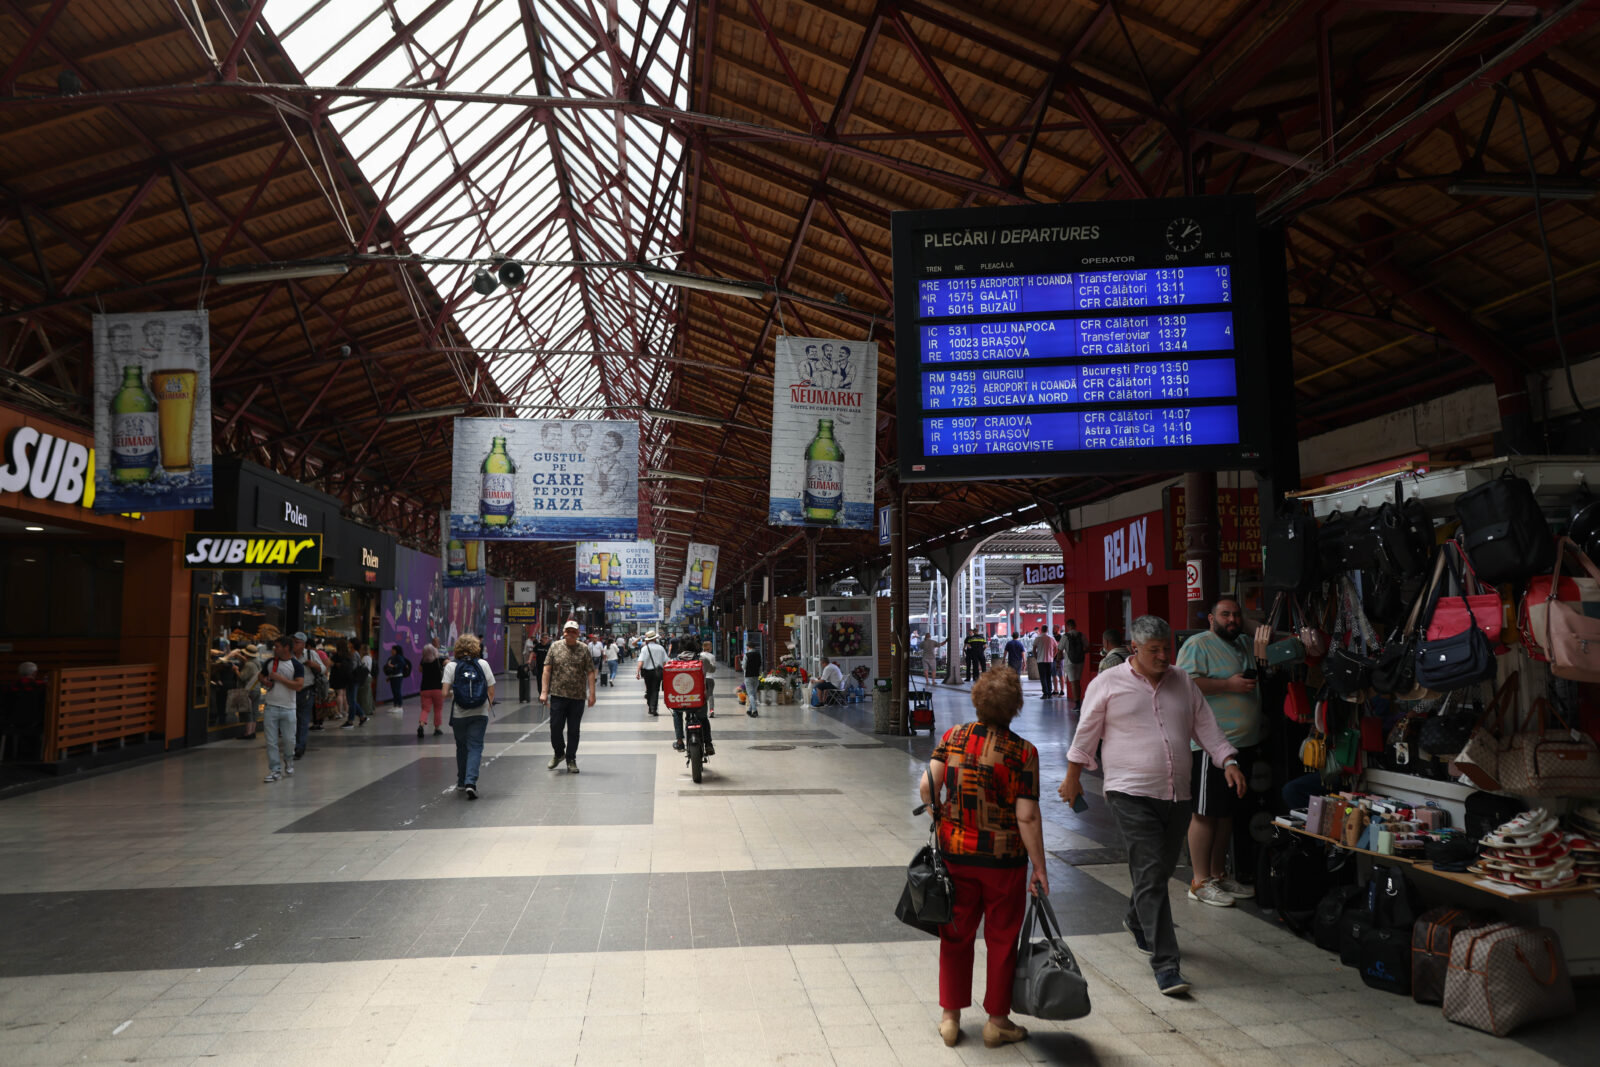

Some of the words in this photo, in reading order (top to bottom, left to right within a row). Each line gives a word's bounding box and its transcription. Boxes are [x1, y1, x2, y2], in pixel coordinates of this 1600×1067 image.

[925, 229, 987, 247] PLECĂRI
[992, 230, 996, 244] /
[1001, 226, 1100, 244] DEPARTURES
[1082, 256, 1135, 264] OPERATOR
[948, 280, 976, 290] 10115
[980, 277, 1024, 288] AEROPORT
[1028, 277, 1033, 285] H
[1037, 274, 1072, 285] COANDĂ
[1079, 272, 1147, 283] Transferoviar
[1156, 269, 1183, 279] 13:10
[1216, 267, 1227, 277] 10
[948, 292, 973, 302] 1575
[1080, 287, 1100, 296] CFR
[1104, 284, 1147, 294] Călători
[1157, 282, 1184, 292] 13:11
[1222, 280, 1228, 289] 6
[928, 306, 934, 315] R
[948, 304, 974, 314] 5015
[981, 302, 1016, 312] BUZĂU
[1080, 299, 1100, 308] CFR
[1105, 296, 1147, 307] Călători
[1157, 294, 1185, 304] 13:17
[1223, 292, 1229, 301] 2
[928, 328, 937, 336] IC
[949, 327, 966, 335] 531
[981, 325, 1007, 334] CLUJ
[1011, 322, 1055, 332] NAPOCA
[1080, 320, 1101, 330] CFR
[1106, 317, 1148, 328] Călători
[1158, 316, 1186, 326] 13:30
[929, 340, 937, 348] IR
[950, 338, 978, 347] 10023
[1081, 331, 1150, 342] Transferoviar
[1159, 328, 1187, 338] 13:37
[1225, 326, 1230, 335] 4
[929, 352, 941, 361] RE
[950, 350, 979, 360] 13053
[982, 348, 1030, 359] CRAIOVA
[1082, 345, 1102, 354] CFR
[1107, 342, 1150, 353] Călători
[1159, 341, 1187, 351] 13:44
[929, 374, 944, 383] RM
[950, 372, 976, 381] 9459
[983, 370, 1023, 380] GIURGIU
[1134, 364, 1157, 374] Prog
[1160, 362, 1188, 373] 13:50
[790, 381, 864, 407] NEUMARKT
[930, 386, 944, 395] RM
[951, 384, 976, 394] 7925
[984, 382, 1028, 393] AEROPORT
[1032, 382, 1037, 390] H
[1041, 379, 1077, 390] COANDĂ
[1083, 379, 1104, 388] CFR
[1108, 376, 1151, 387] Călători
[1161, 375, 1189, 385] 13:50
[931, 399, 939, 407] IR
[952, 396, 976, 406] 1753
[984, 394, 1034, 405] SUCEAVA
[1039, 392, 1068, 402] NORD
[1084, 391, 1104, 401] CFR
[1109, 388, 1152, 399] Călători
[1161, 387, 1189, 397] 14:01
[931, 420, 944, 429] RE
[952, 418, 977, 428] 9907
[984, 416, 1032, 427] CRAIOVA
[1084, 413, 1105, 422] CFR
[1109, 410, 1152, 421] Călători
[1162, 409, 1190, 419] 14:07
[932, 432, 940, 441] IR
[952, 430, 981, 440] 11535
[1085, 426, 1110, 436] Astra
[1114, 424, 1139, 434] Trans
[1143, 423, 1155, 433] Ca
[1163, 422, 1191, 432] 14:10
[932, 445, 938, 453] R
[953, 443, 978, 453] 9107
[1086, 438, 1106, 448] CFR
[1111, 436, 1154, 447] Călători
[1163, 434, 1192, 444] 14:16
[534, 453, 585, 462] GUSTUL
[533, 473, 584, 485] CARE
[533, 487, 548, 496] TE
[553, 487, 583, 496] POTI
[285, 501, 307, 527] Polen
[534, 498, 584, 510] BAZA
[186, 538, 315, 565] SUBWAY
[362, 547, 379, 568] Polen
[1025, 564, 1064, 584] tabac
[668, 694, 701, 703] tazz
